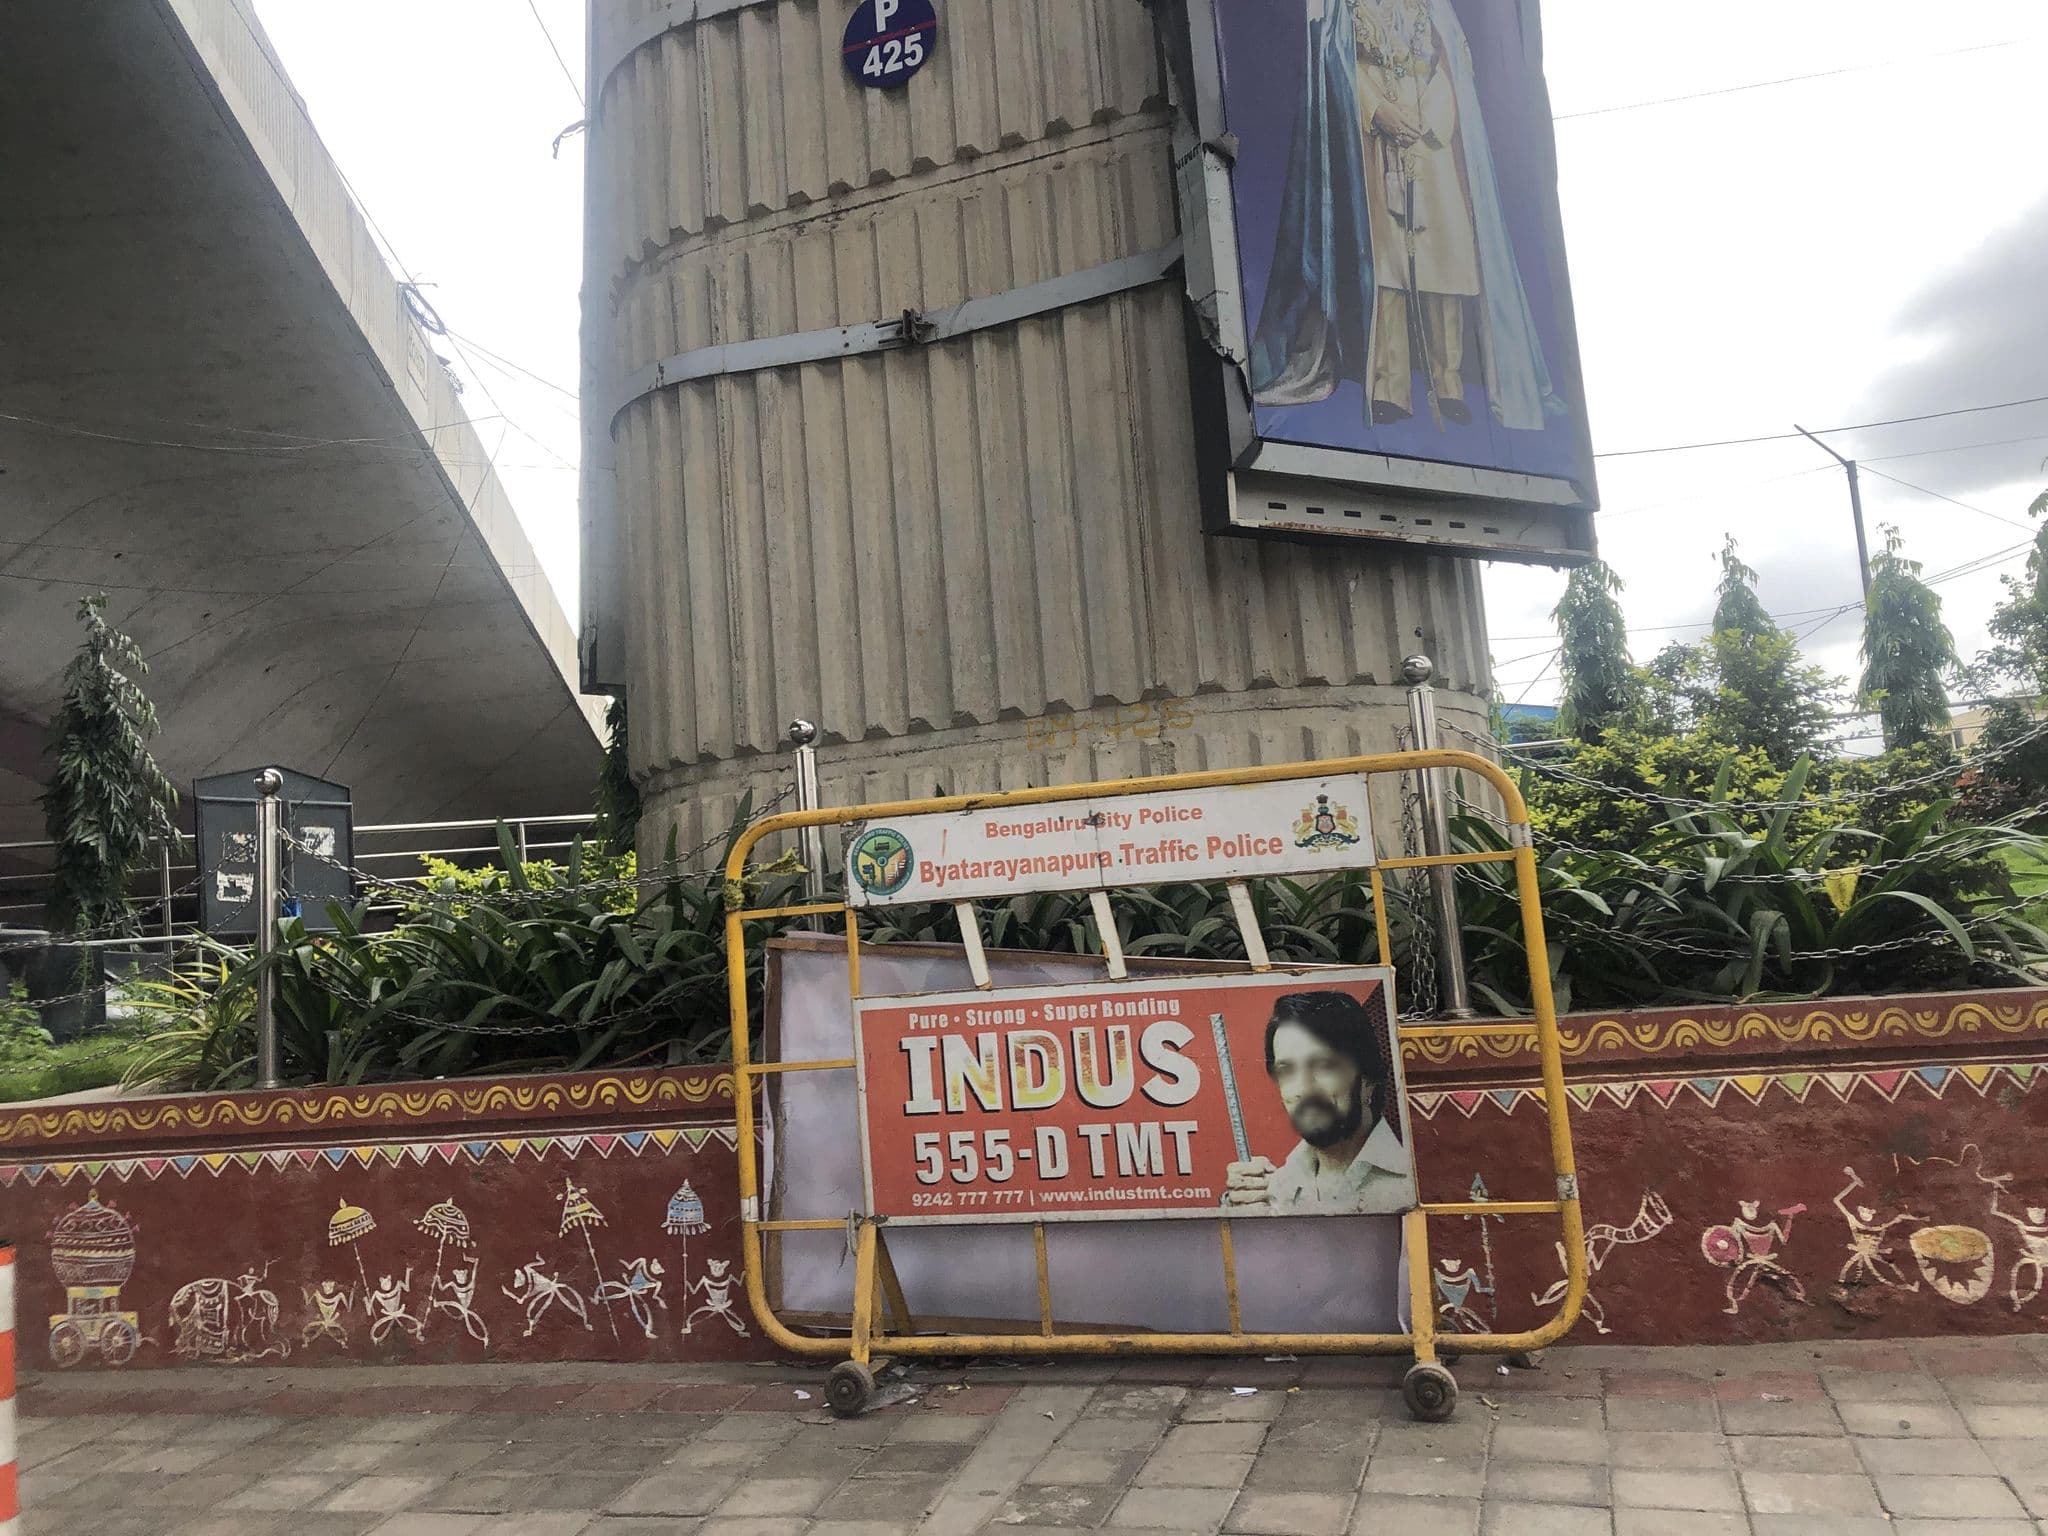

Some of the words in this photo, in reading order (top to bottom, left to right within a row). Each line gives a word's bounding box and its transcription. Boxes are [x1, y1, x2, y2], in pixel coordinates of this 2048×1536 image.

[875, 0, 899, 33] P
[863, 32, 923, 77] 425
[985, 816, 1087, 839] Bengaluru
[1092, 811, 1132, 830] City
[1138, 806, 1203, 825] Police
[919, 848, 1113, 888] Byatarayanapura
[1119, 839, 1199, 866] Traffic
[1206, 834, 1284, 860] Police
[909, 1013, 949, 1030] Pure
[966, 1009, 1025, 1026] Strong
[1043, 1003, 1097, 1021] Super
[1101, 998, 1181, 1018] Bonding
[901, 1020, 1201, 1115] INDUS
[914, 1125, 1070, 1185] 555-D
[1078, 1120, 1199, 1177] TMT
[911, 1192, 953, 1208] 9242
[957, 1191, 989, 1206] 777
[992, 1190, 1025, 1205] 777
[1038, 1185, 1212, 1204] www.industmt.com
